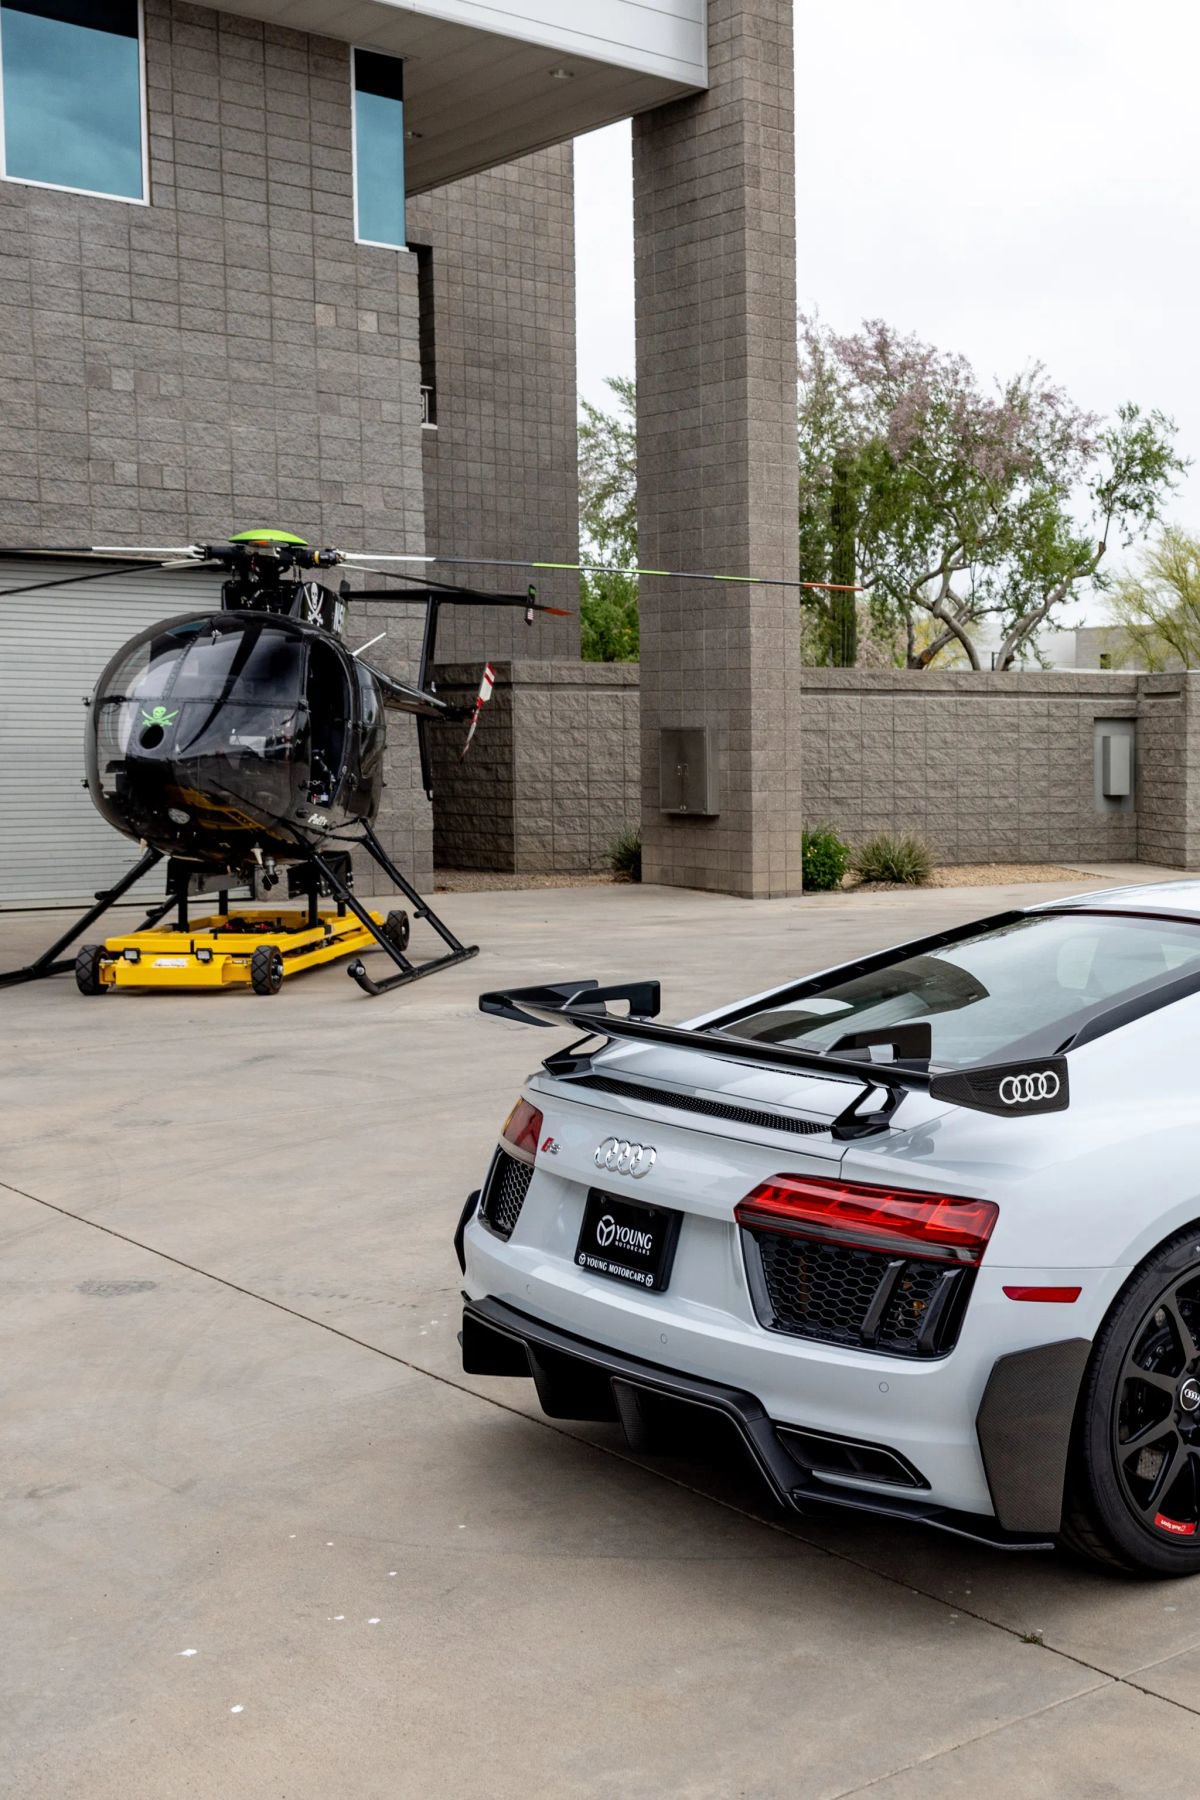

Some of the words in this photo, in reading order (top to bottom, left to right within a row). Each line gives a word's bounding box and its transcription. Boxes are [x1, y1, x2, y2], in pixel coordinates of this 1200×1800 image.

[615, 1241, 650, 1256] MOTORCARS
[616, 1225, 653, 1250] YOUNG
[586, 1256, 608, 1271] YOUNG
[608, 1264, 645, 1283] MOTORCARS
